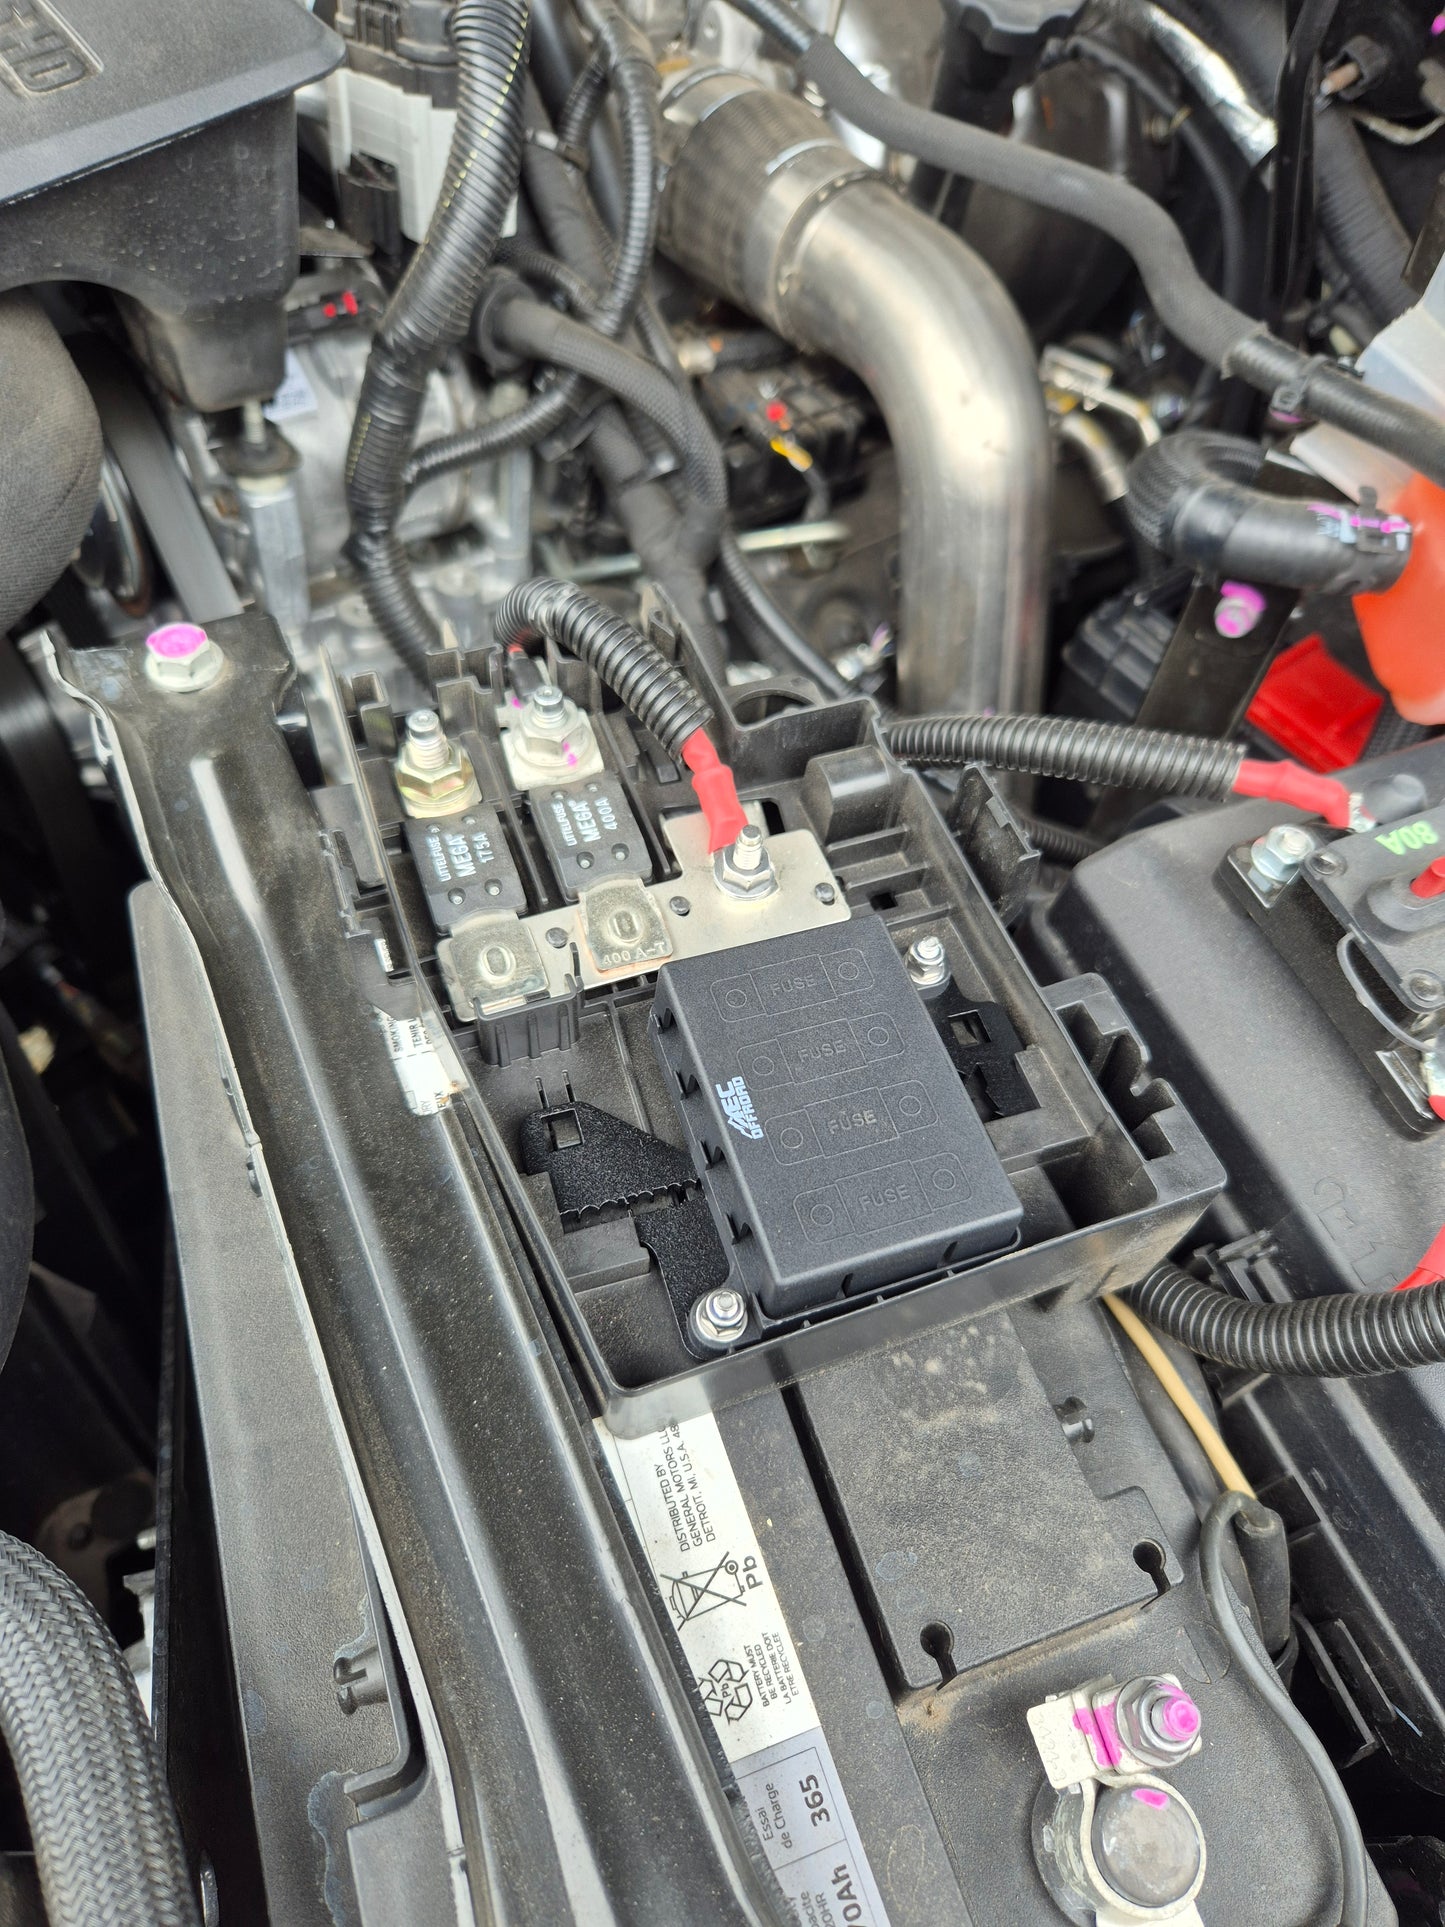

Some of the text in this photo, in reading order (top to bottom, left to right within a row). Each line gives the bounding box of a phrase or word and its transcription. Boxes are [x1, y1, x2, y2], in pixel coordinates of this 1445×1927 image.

[551, 802, 577, 846] LITTELFUSE
[595, 797, 618, 830] 400A
[472, 832, 495, 863] 175A
[1374, 820, 1439, 855] 80A
[426, 836, 452, 882] LITTELFUSE
[603, 950, 631, 966] 400
[770, 974, 818, 996] FUSE
[409, 1024, 422, 1048] TENIR
[798, 1039, 847, 1062] FUSE
[732, 1076, 764, 1139] OFFROAD
[827, 1109, 877, 1134] FUSE
[859, 1185, 910, 1210] FUSE
[664, 1446, 686, 1493] MOTORS
[678, 1441, 693, 1472] U.S.A.
[654, 1464, 690, 1552] DISTRIBUTED BY
[681, 1494, 703, 1547] GENERAL
[742, 1555, 763, 1589] Pb
[743, 1645, 770, 1707] BATTERY MUST
[754, 1644, 778, 1700] BE RECYCLED
[761, 1632, 792, 1705] LA BATTERIE DOIT
[772, 1632, 799, 1697] ETRE RECYCLEE
[720, 1683, 732, 1698] Pb
[766, 1782, 793, 1849] de Charge
[799, 1774, 831, 1827] 365
[757, 1807, 774, 1841] Essai
[831, 1864, 868, 1927] 0Ah
